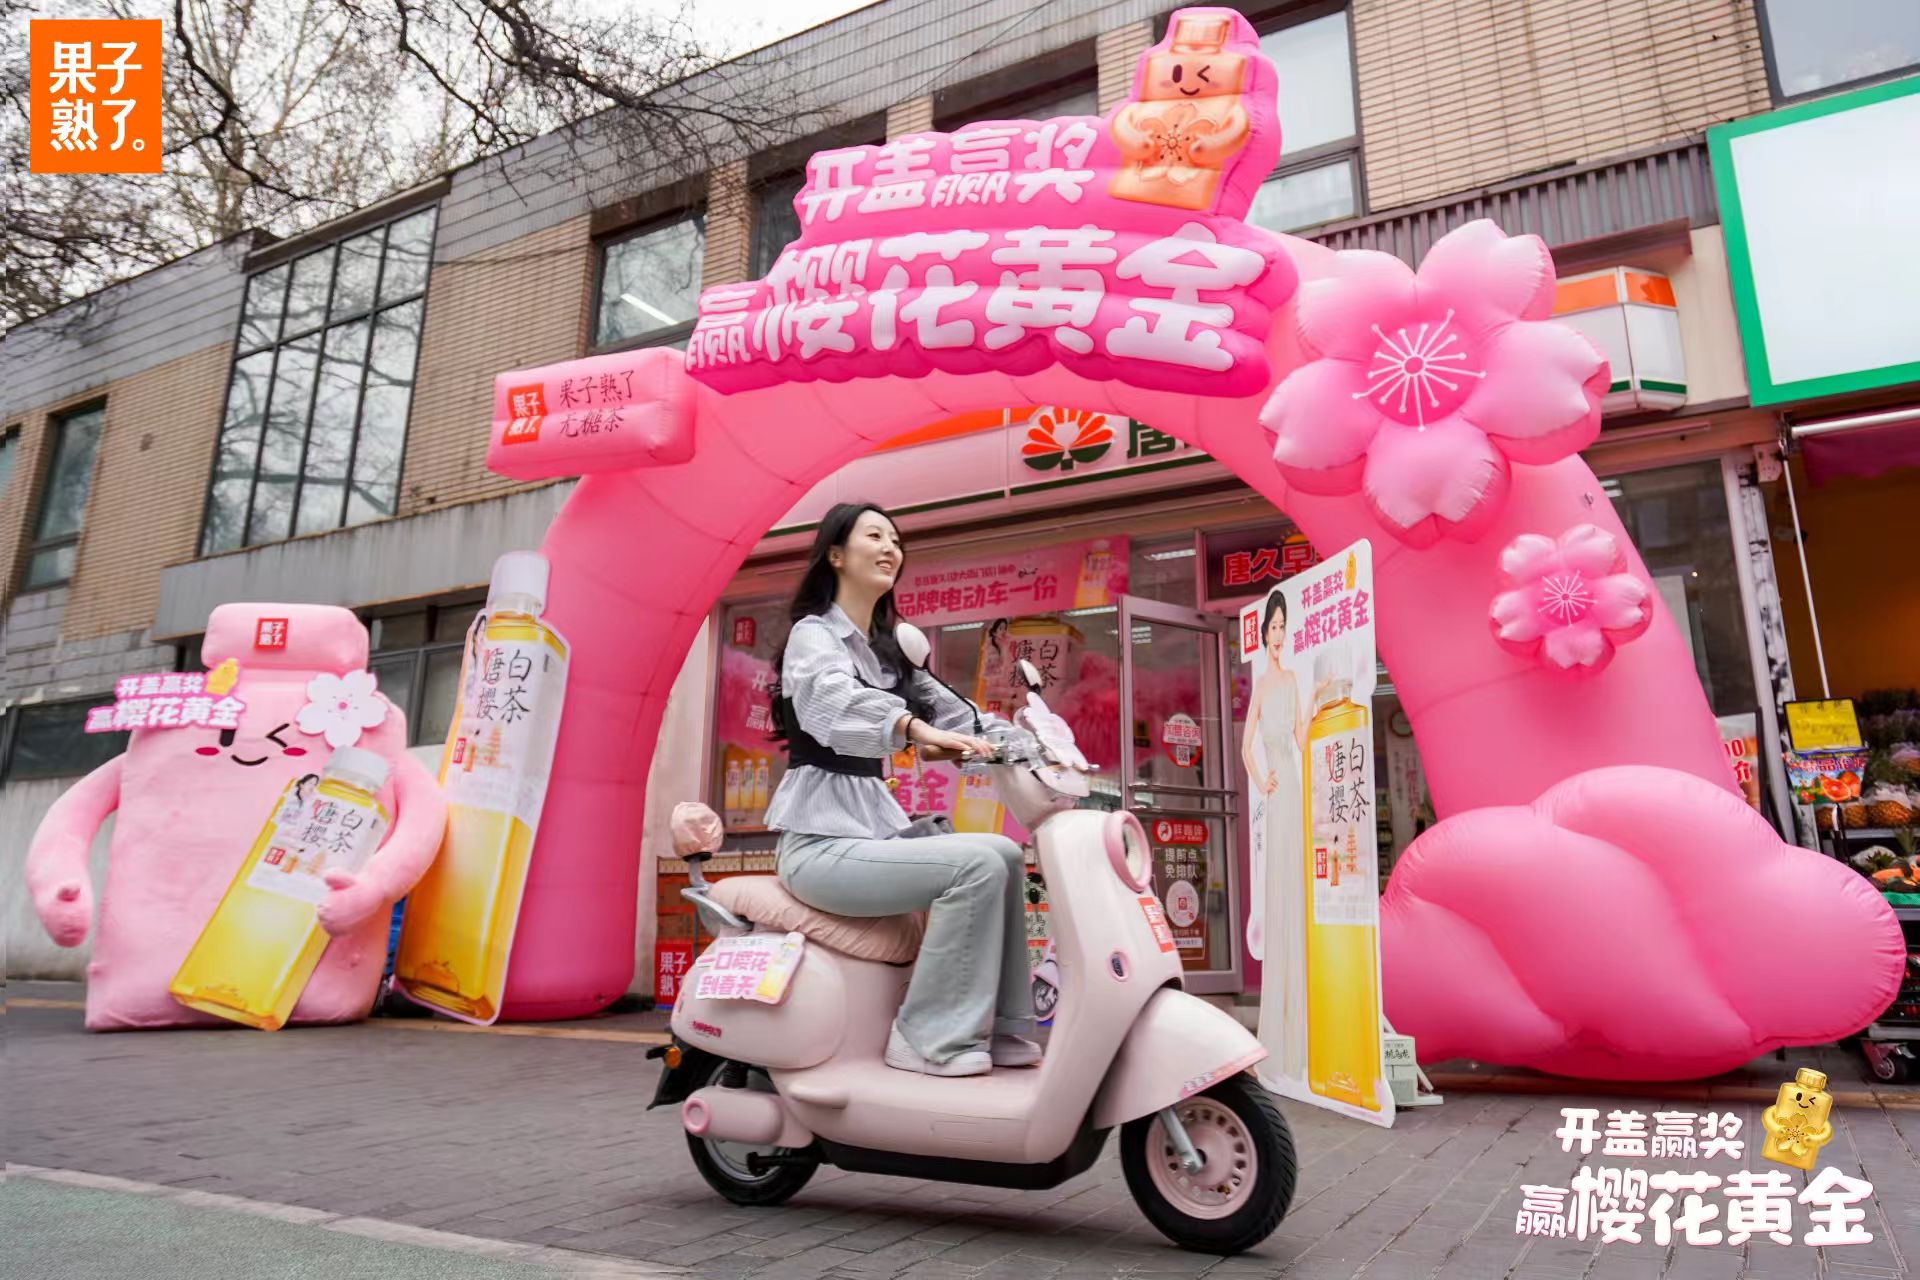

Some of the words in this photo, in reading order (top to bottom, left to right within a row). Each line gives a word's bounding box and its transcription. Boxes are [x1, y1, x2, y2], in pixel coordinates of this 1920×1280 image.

[801, 122, 1099, 226] 开盖赢奖
[684, 221, 1266, 371] 赢樱花黄金
[512, 391, 540, 417] 果子
[560, 370, 634, 408] 果子熟了
[560, 406, 624, 438] 无糖茶
[1223, 544, 1325, 587] 唐久早
[897, 575, 1058, 617] 品牌电动车一份
[1301, 570, 1344, 610] 开盖赢奖
[1293, 589, 1369, 656] 赢樱花黄金
[1039, 639, 1058, 690] 白茶
[118, 675, 204, 697] 开盖赢奖
[501, 649, 531, 725] 白茶
[89, 696, 246, 729] 赢樱花黄金
[1350, 737, 1370, 824] 白茶
[329, 808, 363, 853] 白茶
[1165, 863, 1198, 879] 免排队
[660, 951, 688, 974] 果子
[698, 951, 771, 971] 一口樱花
[698, 975, 756, 996] 到春天
